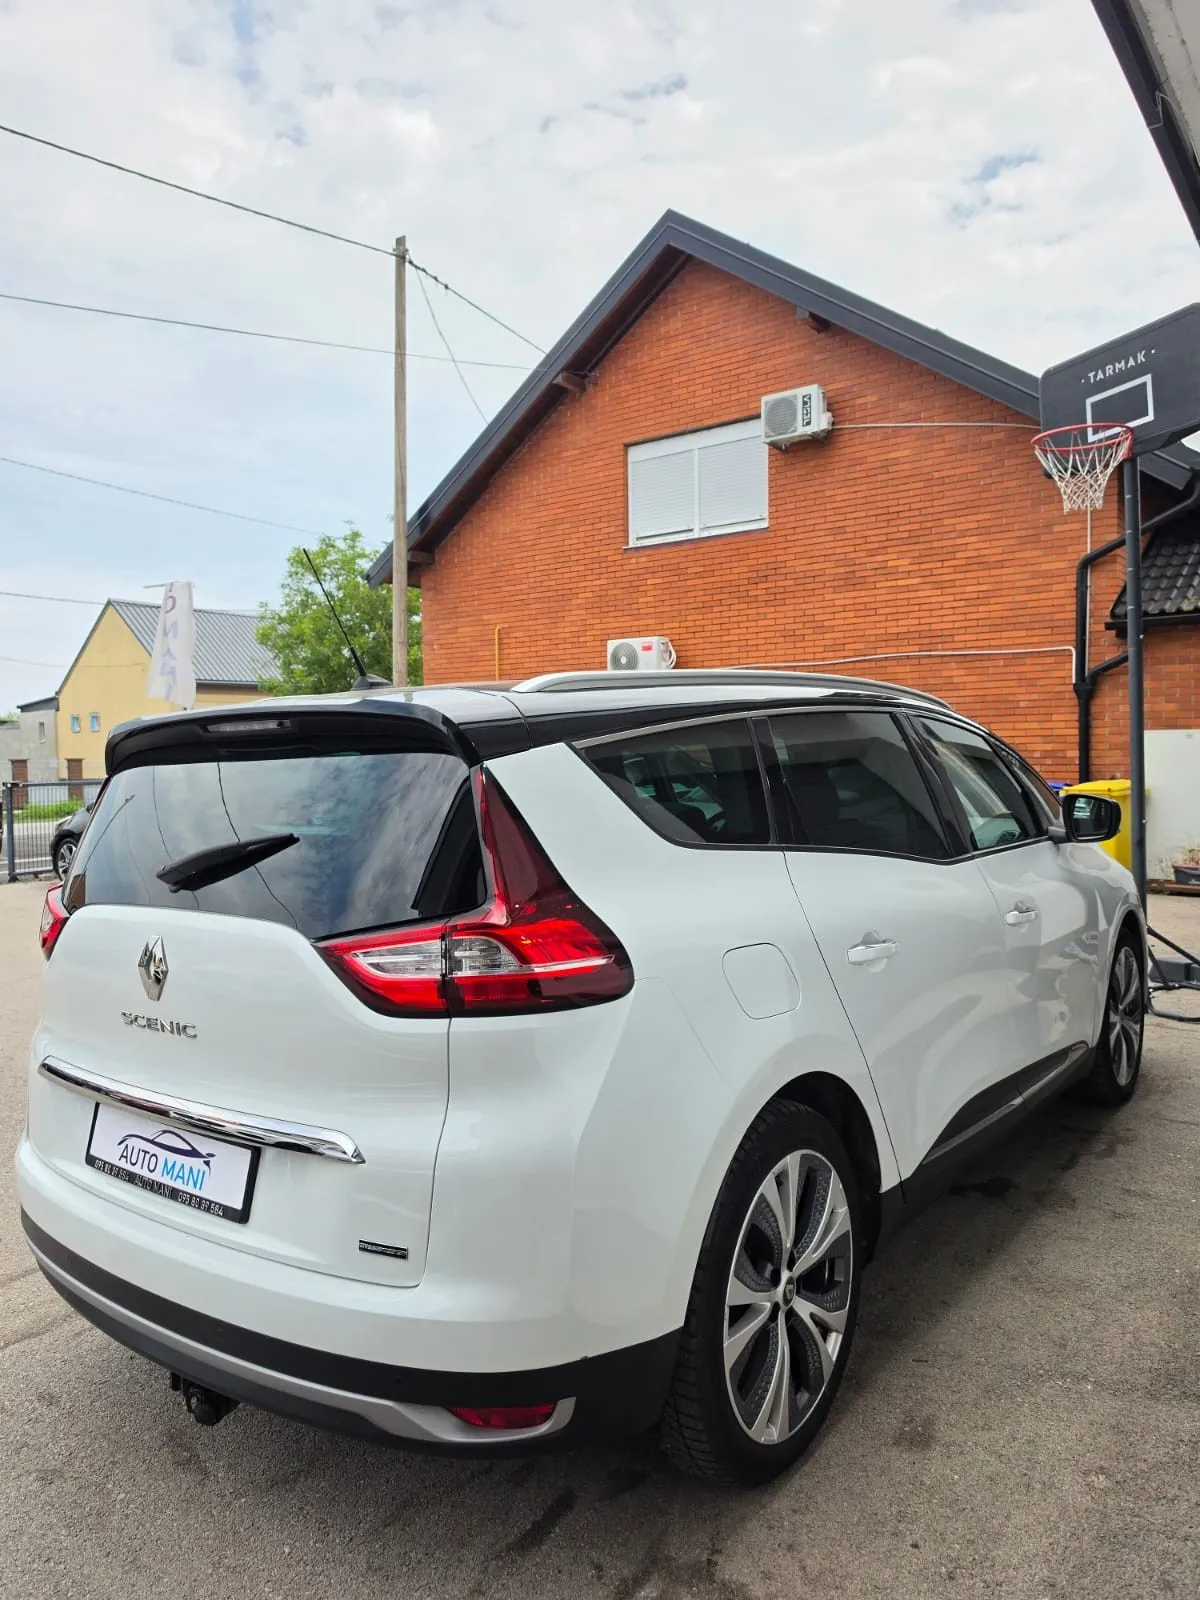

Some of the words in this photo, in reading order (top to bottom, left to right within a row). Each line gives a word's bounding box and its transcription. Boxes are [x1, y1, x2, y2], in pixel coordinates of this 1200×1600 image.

[1087, 350, 1147, 384] TARMAK
[120, 1010, 198, 1039] SCENIC
[118, 1144, 158, 1173] AUTO
[160, 1157, 207, 1191] MANI
[178, 1192, 190, 1204] 095
